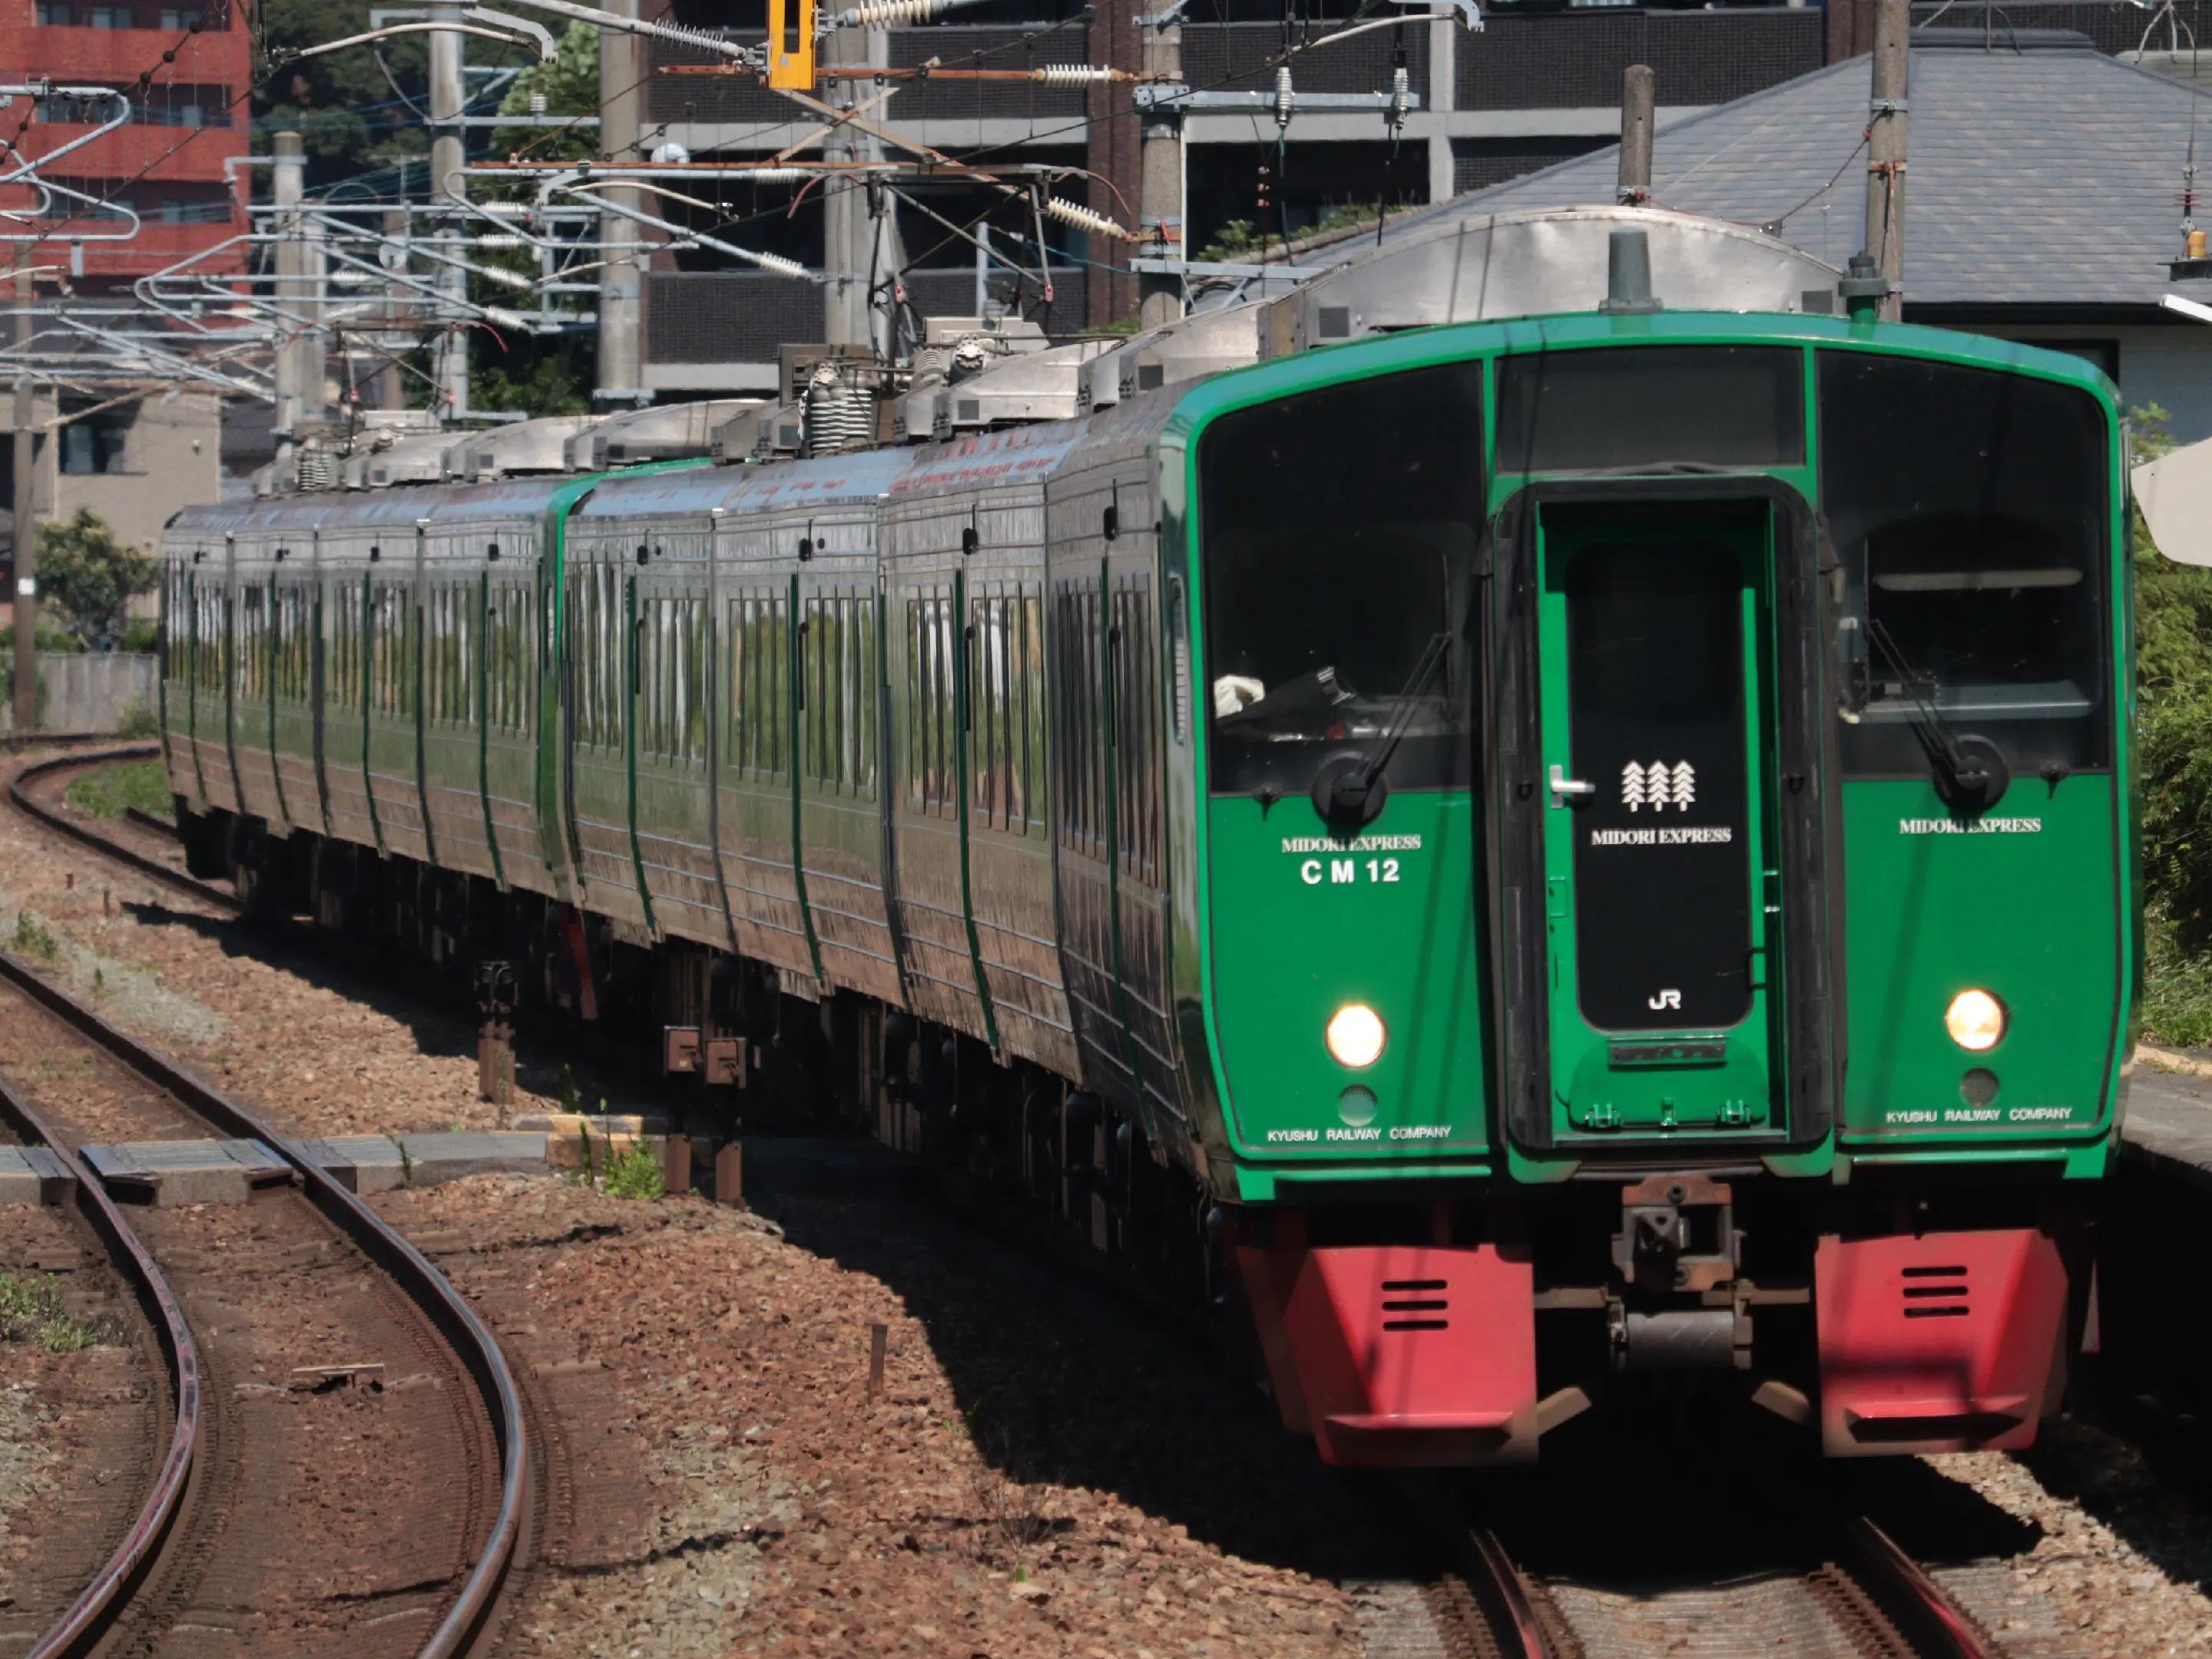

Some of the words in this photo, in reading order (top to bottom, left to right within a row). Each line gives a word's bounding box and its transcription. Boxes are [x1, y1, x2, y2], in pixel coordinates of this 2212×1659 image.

[1899, 818, 1965, 834] MIDORI
[1966, 816, 2042, 833] EXPRESS
[1281, 836, 1346, 853] MIDORI
[1349, 834, 1422, 851] EXPRESS
[1591, 829, 1655, 845] MIDORI
[1657, 826, 1732, 844] EXPRESS
[1648, 988, 1681, 1010] JR
[1886, 1110, 1938, 1124] KYUSHU
[1945, 1108, 2001, 1122] RAILWAY
[2009, 1106, 2073, 1121] COMPANY
[1267, 1129, 1319, 1142] KYUSHU
[1326, 1127, 1382, 1141] RAILWAY
[1389, 1124, 1452, 1140] COMPANY
